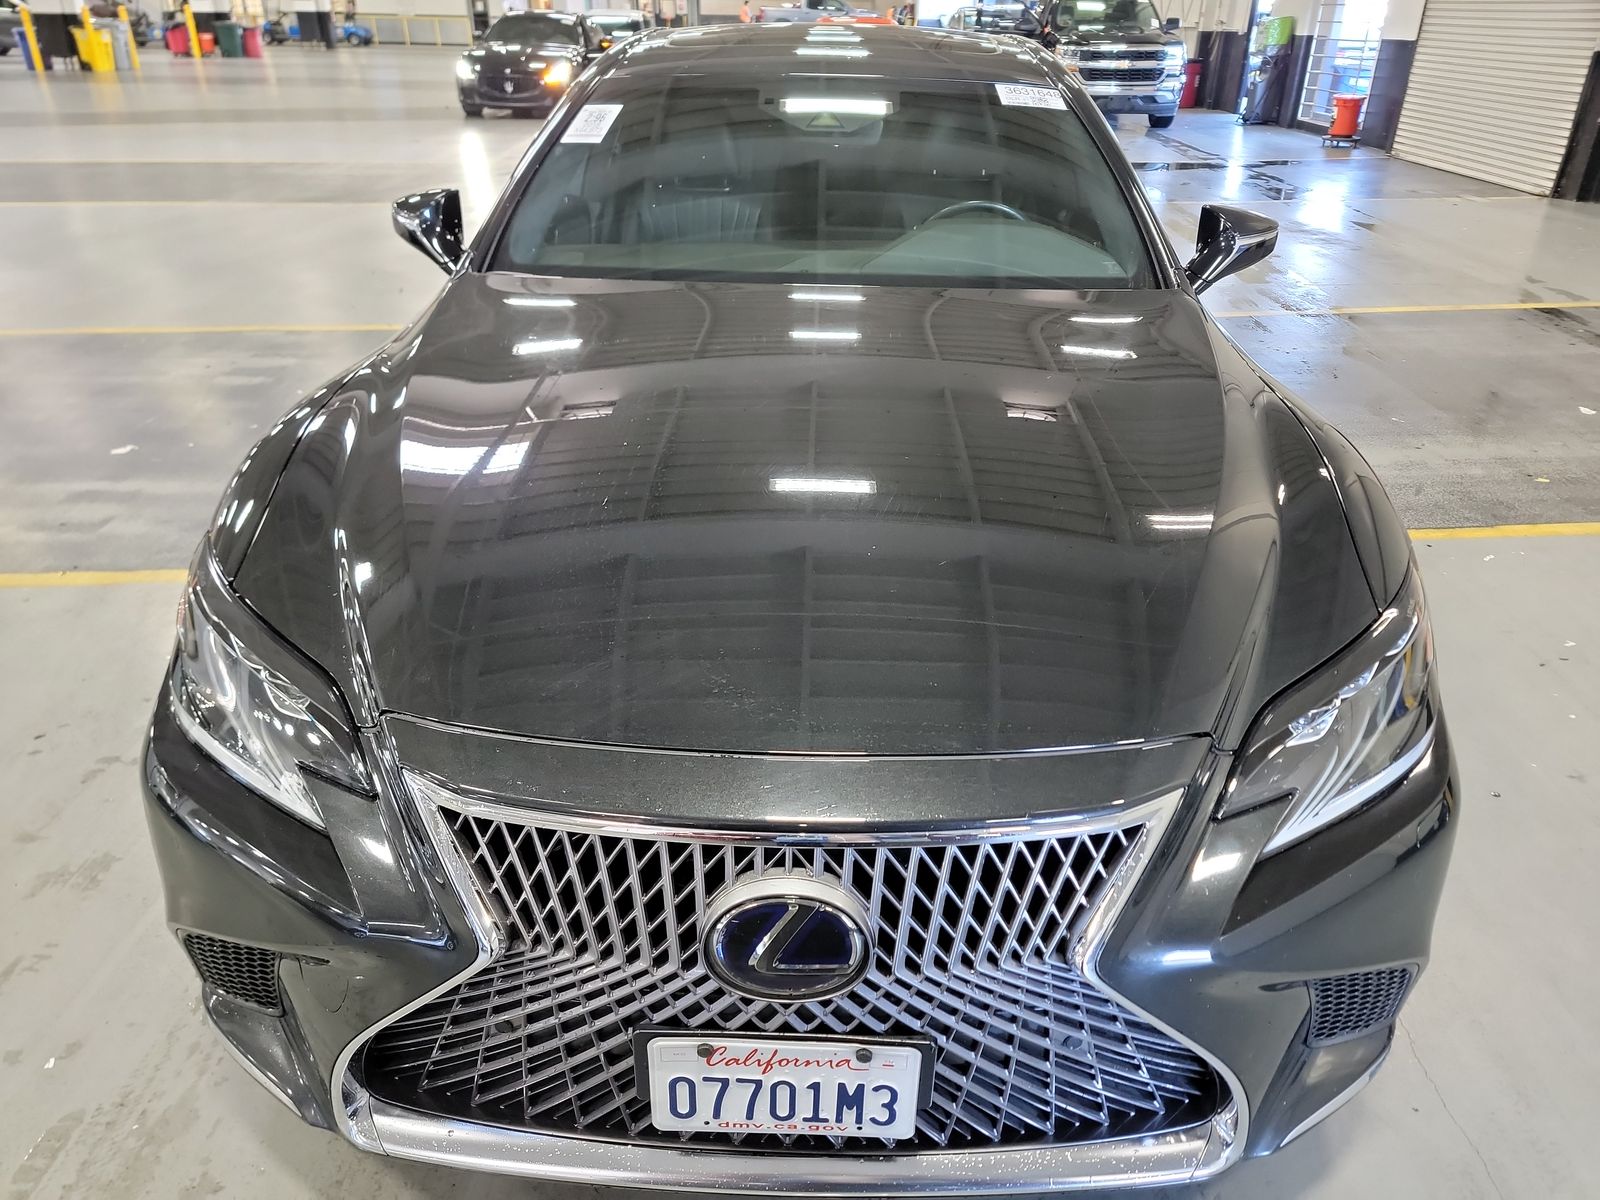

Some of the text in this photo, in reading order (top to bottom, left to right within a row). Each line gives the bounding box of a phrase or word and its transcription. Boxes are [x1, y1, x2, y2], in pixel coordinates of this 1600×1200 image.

[705, 1045, 870, 1075] California
[668, 1076, 899, 1126] 07701M3
[717, 1121, 849, 1132] dmv.ca.gov
